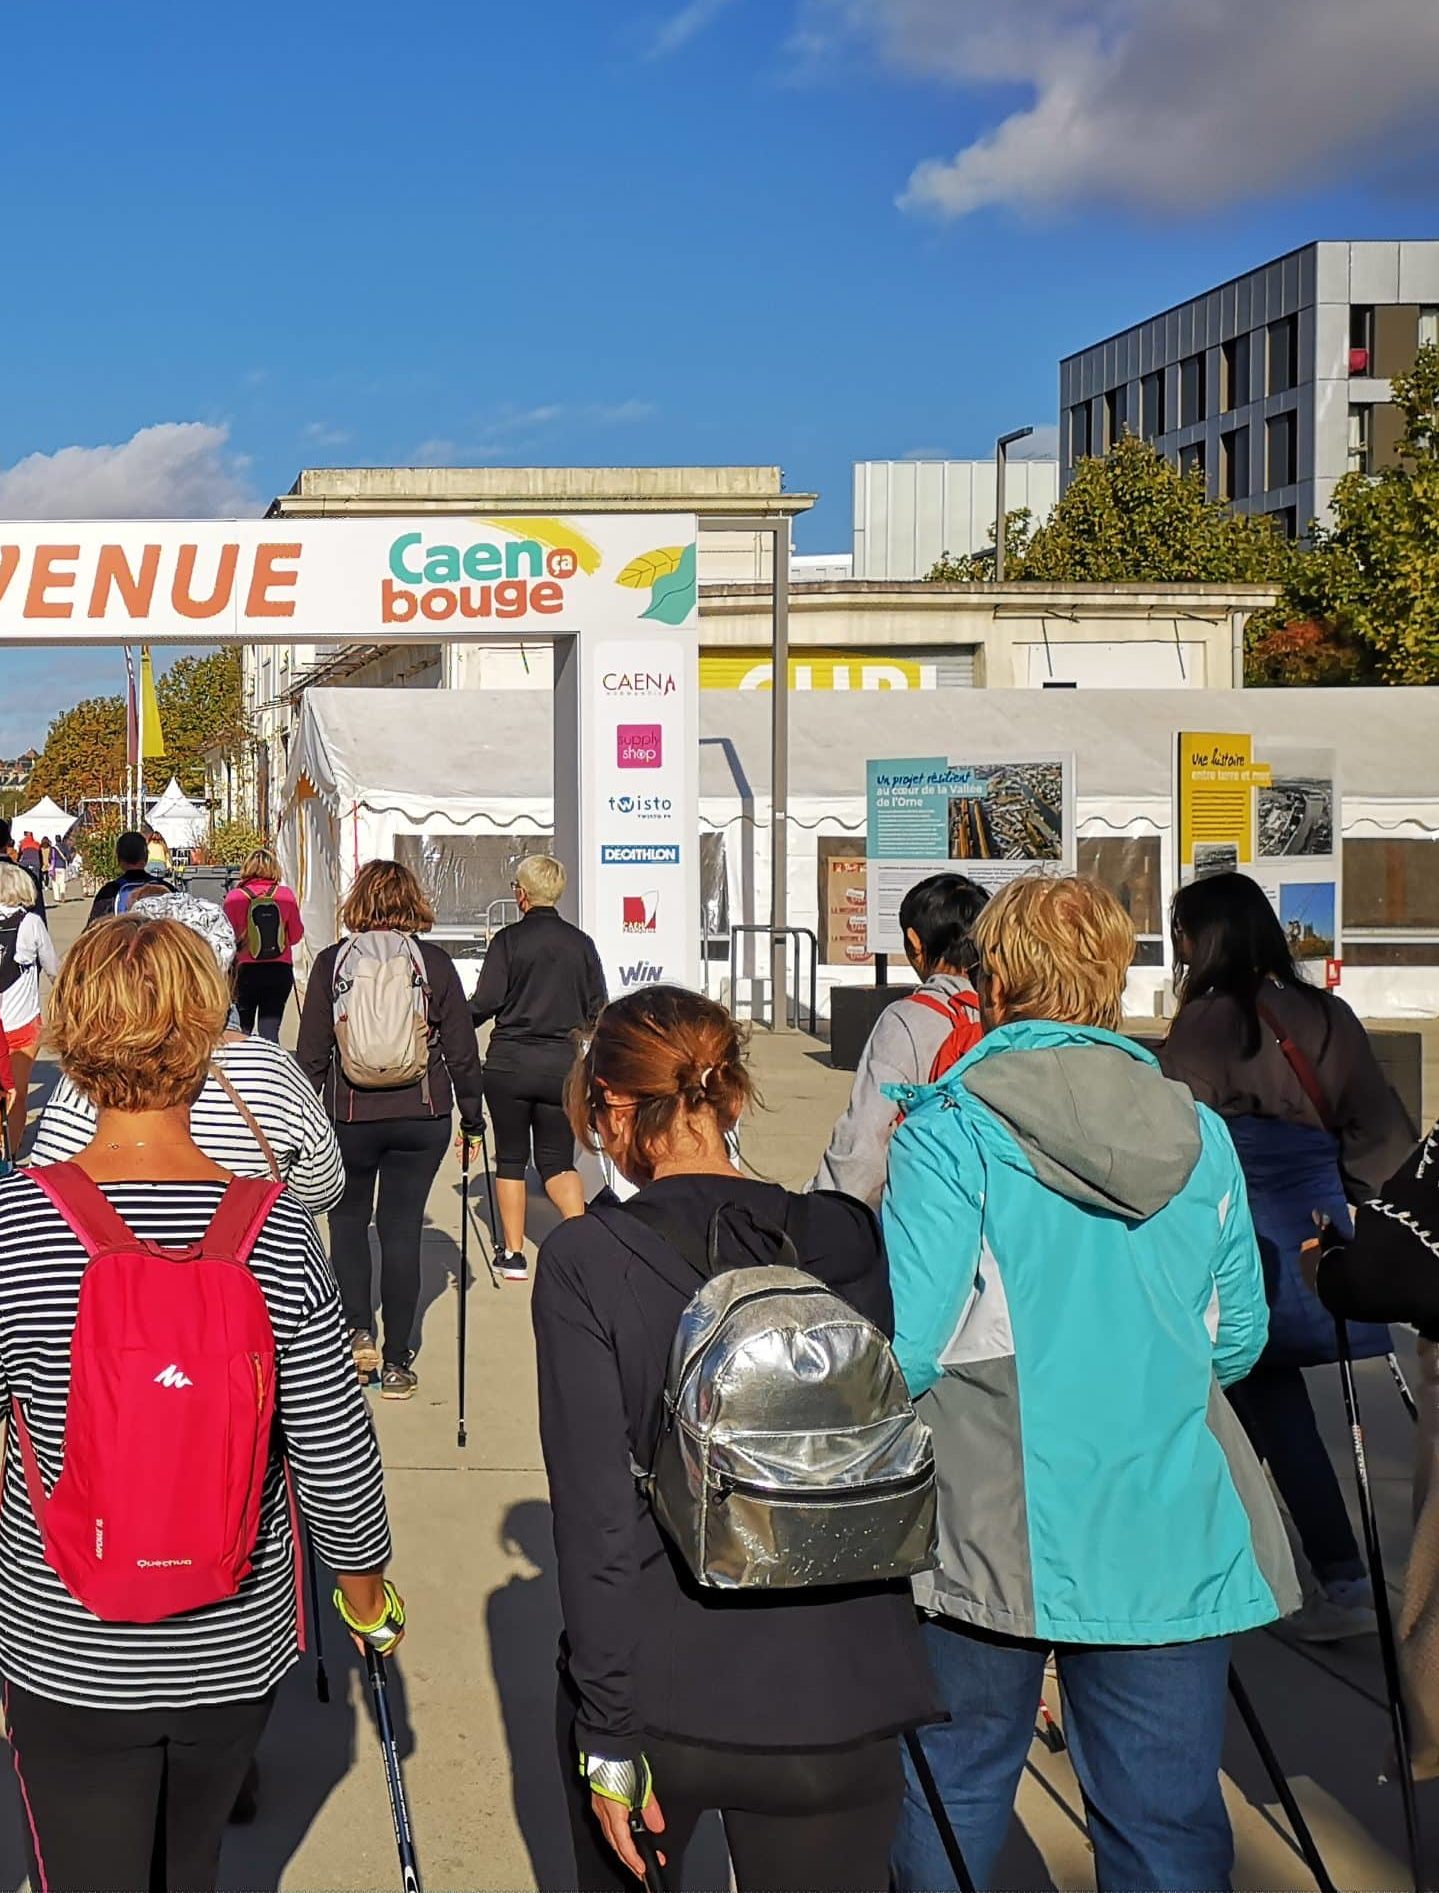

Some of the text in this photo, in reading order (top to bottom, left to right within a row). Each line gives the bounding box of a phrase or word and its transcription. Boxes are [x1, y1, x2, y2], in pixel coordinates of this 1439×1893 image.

[389, 532, 543, 585] Caen
[382, 578, 564, 624] bouge
[602, 672, 663, 692] CAEN
[622, 747, 657, 763] shop
[1192, 747, 1246, 768] Une histoire
[876, 774, 890, 786] Un
[892, 772, 924, 789] projet
[876, 784, 983, 796] au cœur de la Vallée
[608, 795, 672, 814] twisto
[876, 797, 924, 807] de l'Orne
[604, 848, 676, 862] DECATHLON
[136, 1559, 193, 1569] Quechua
